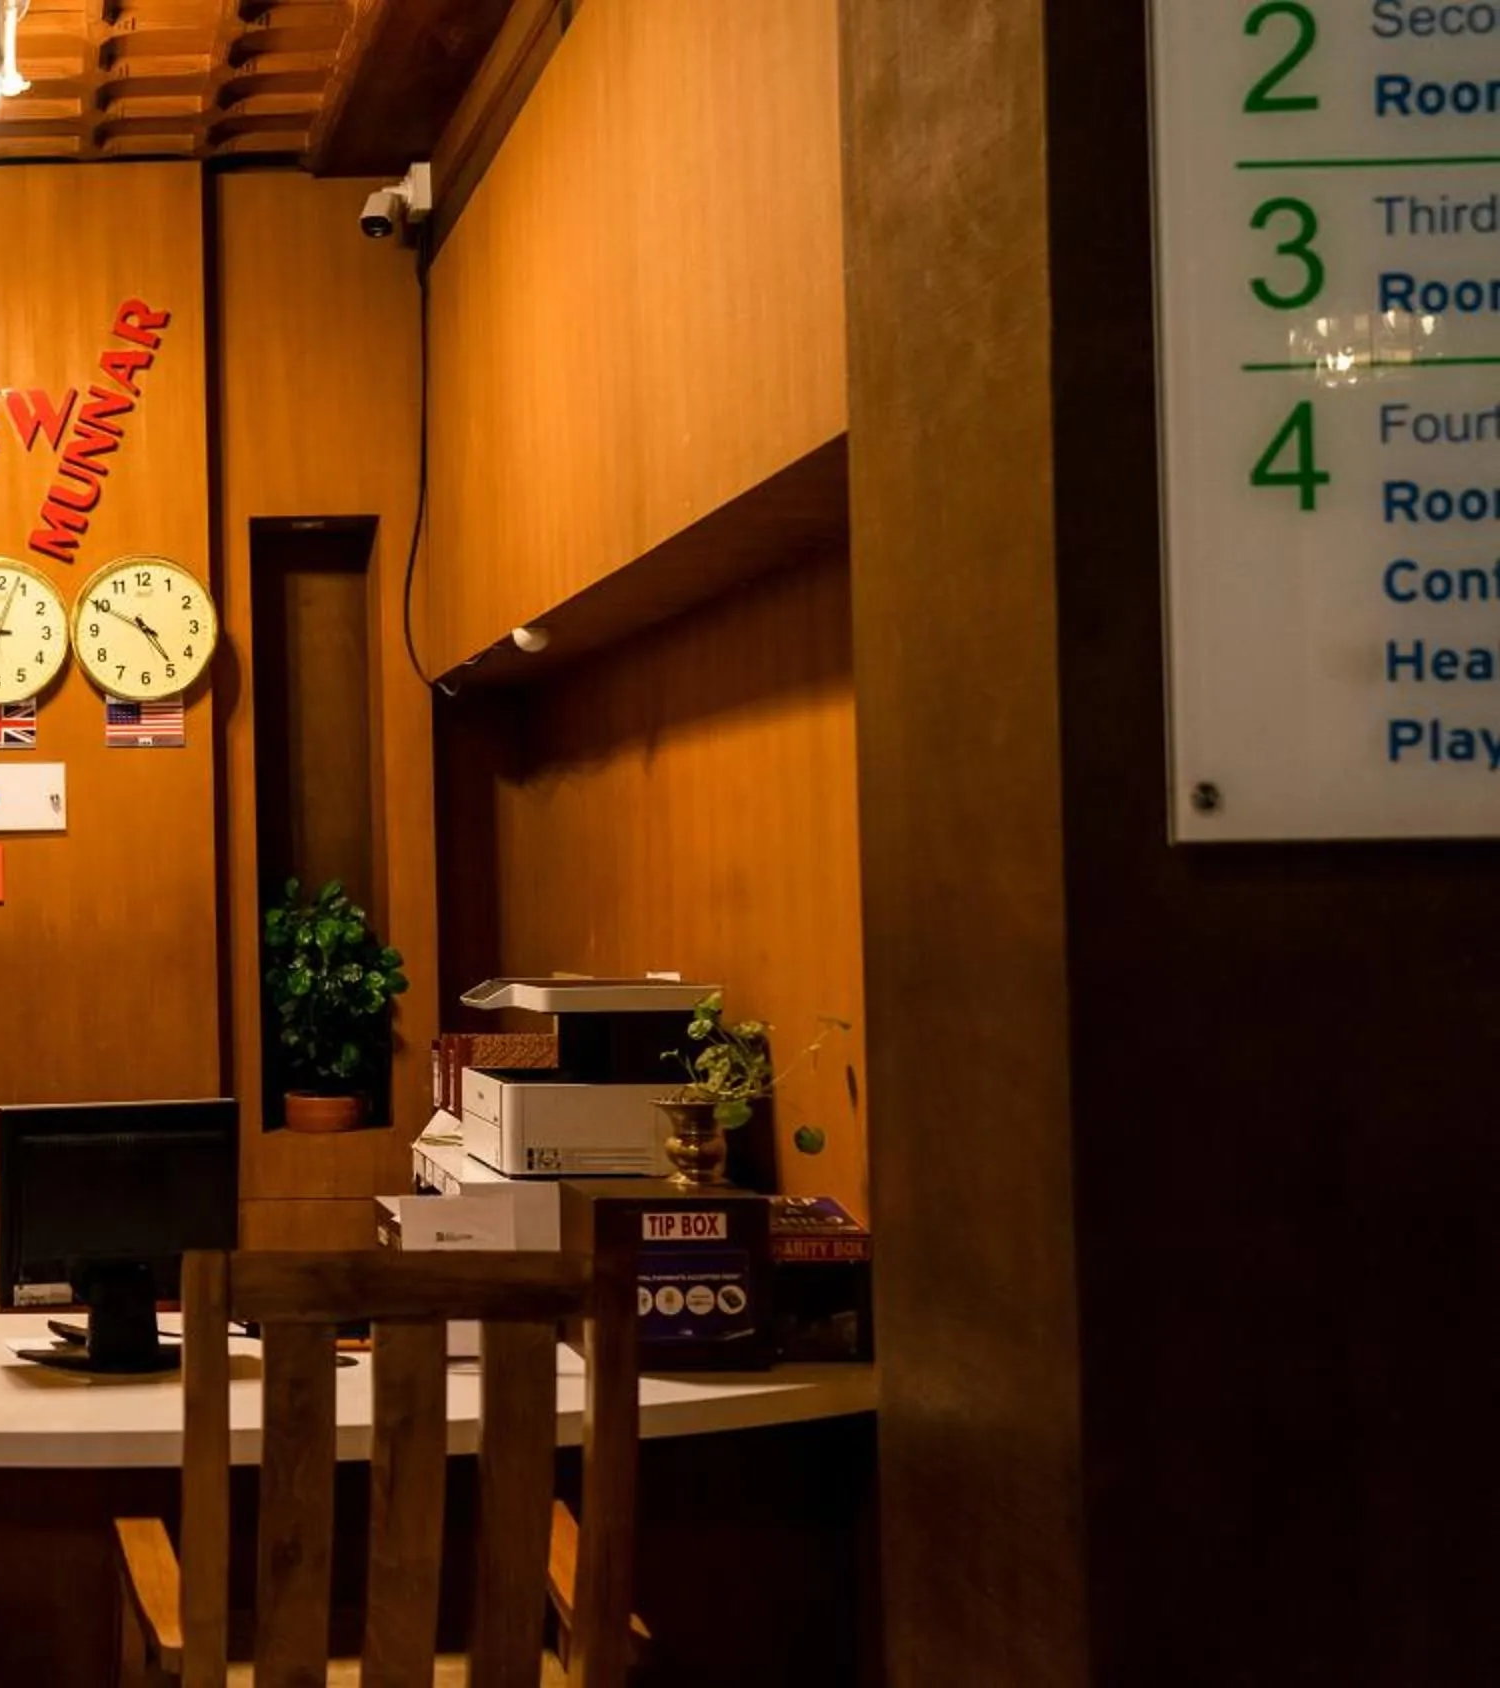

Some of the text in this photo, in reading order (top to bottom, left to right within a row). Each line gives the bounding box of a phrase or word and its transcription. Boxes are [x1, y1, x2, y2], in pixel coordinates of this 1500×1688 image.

[1243, 0, 1320, 113] 2
[1374, 74, 1500, 117] Roo
[1249, 195, 1499, 311] 3 Third
[1378, 272, 1500, 314] Roo
[28, 297, 171, 564] MUNNAR
[1250, 400, 1330, 511] 4
[1383, 480, 1500, 523] Roo
[112, 580, 126, 593] 11
[135, 573, 151, 587] 12
[165, 579, 171, 592] 1
[20, 584, 27, 596] 1
[35, 602, 45, 615] 2
[94, 600, 110, 613] 10
[182, 596, 192, 609] 2
[41, 626, 51, 639] 3
[89, 624, 99, 637] 9
[189, 620, 199, 633] 3
[35, 651, 45, 664] 4
[97, 649, 107, 662] 8
[183, 645, 193, 658] 4
[1386, 639, 1500, 682] Hea
[17, 669, 26, 682] 5
[115, 666, 125, 679] 7
[165, 664, 175, 677] 5
[140, 672, 151, 685] 6
[1388, 718, 1500, 772] Play
[648, 1215, 719, 1236] TIP BOX
